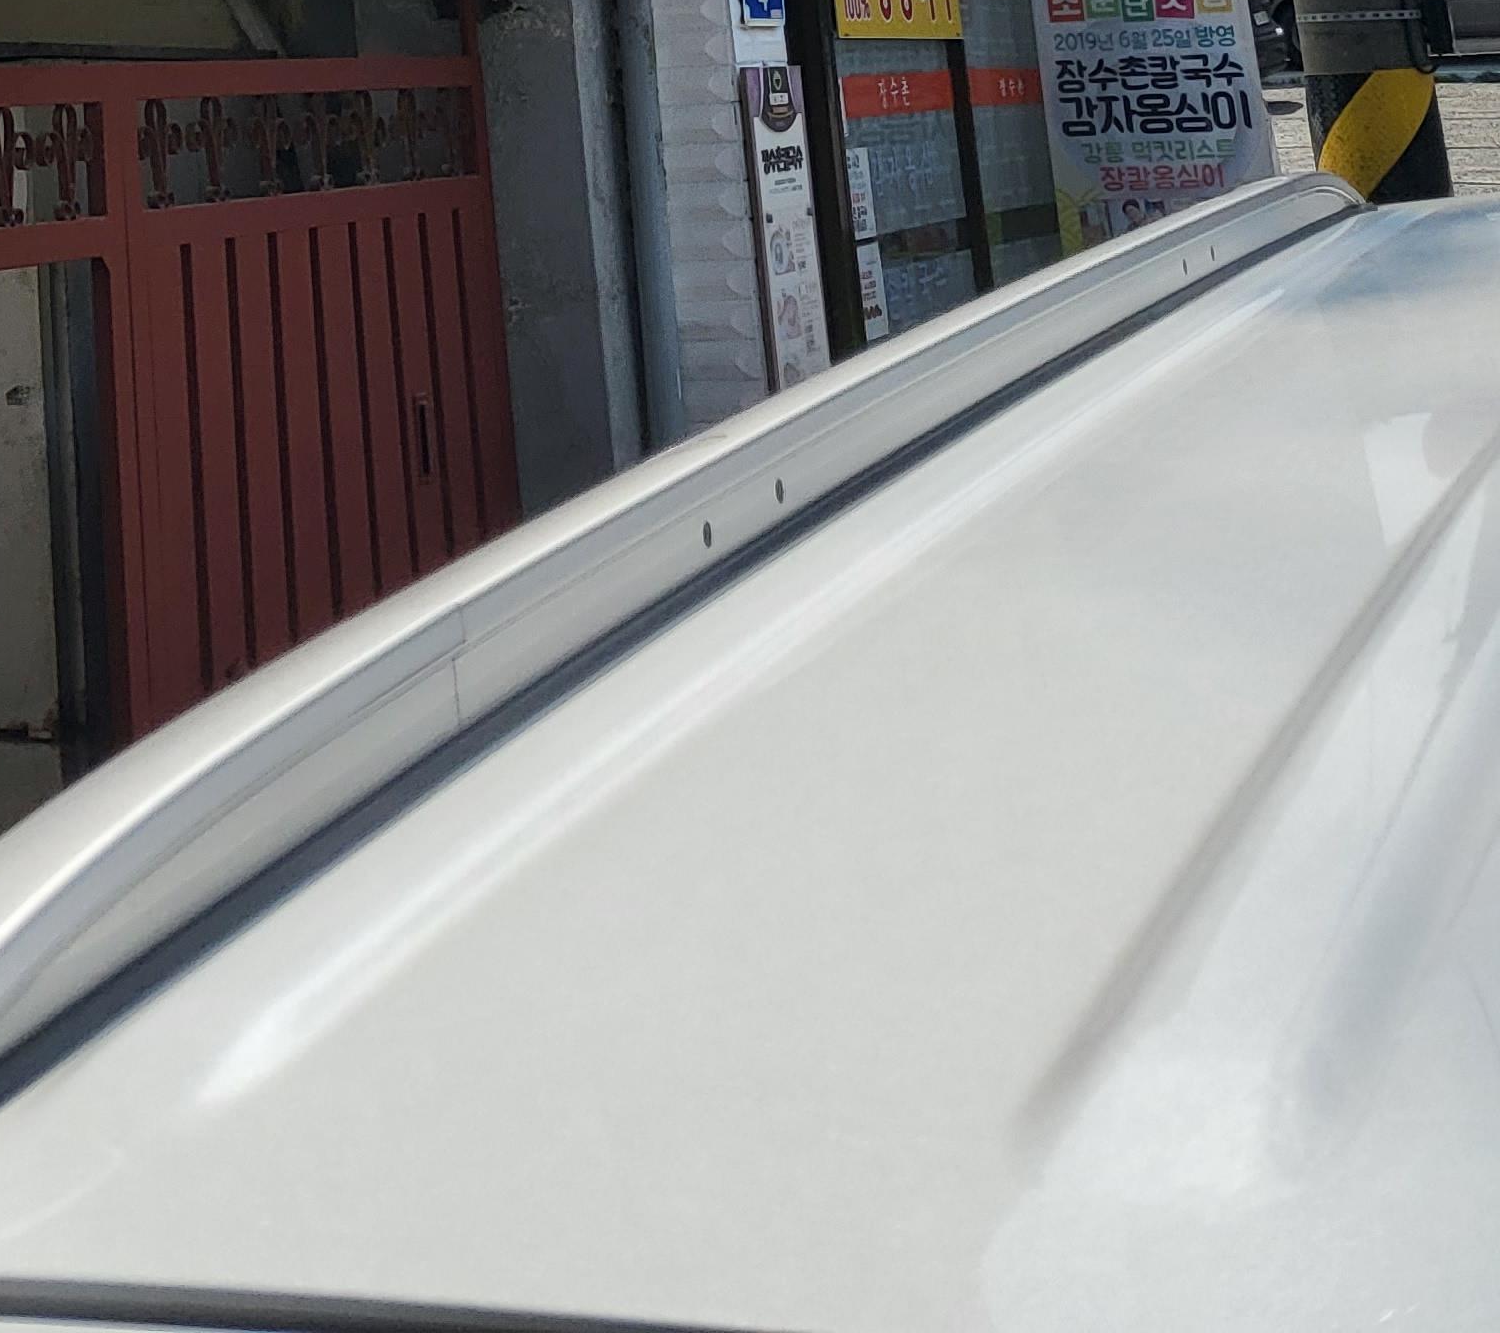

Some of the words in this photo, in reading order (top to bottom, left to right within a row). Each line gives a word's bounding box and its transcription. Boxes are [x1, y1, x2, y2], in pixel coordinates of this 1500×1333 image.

[1054, 31, 1114, 52] 2019년
[1118, 30, 1148, 50] 6월
[1152, 28, 1191, 48] 25일
[1194, 24, 1236, 47] 방영
[1055, 53, 1244, 94] 장수촌칼국수
[1059, 90, 1252, 137] 감자옹심이
[1100, 163, 1224, 192] 장칼옹심이
